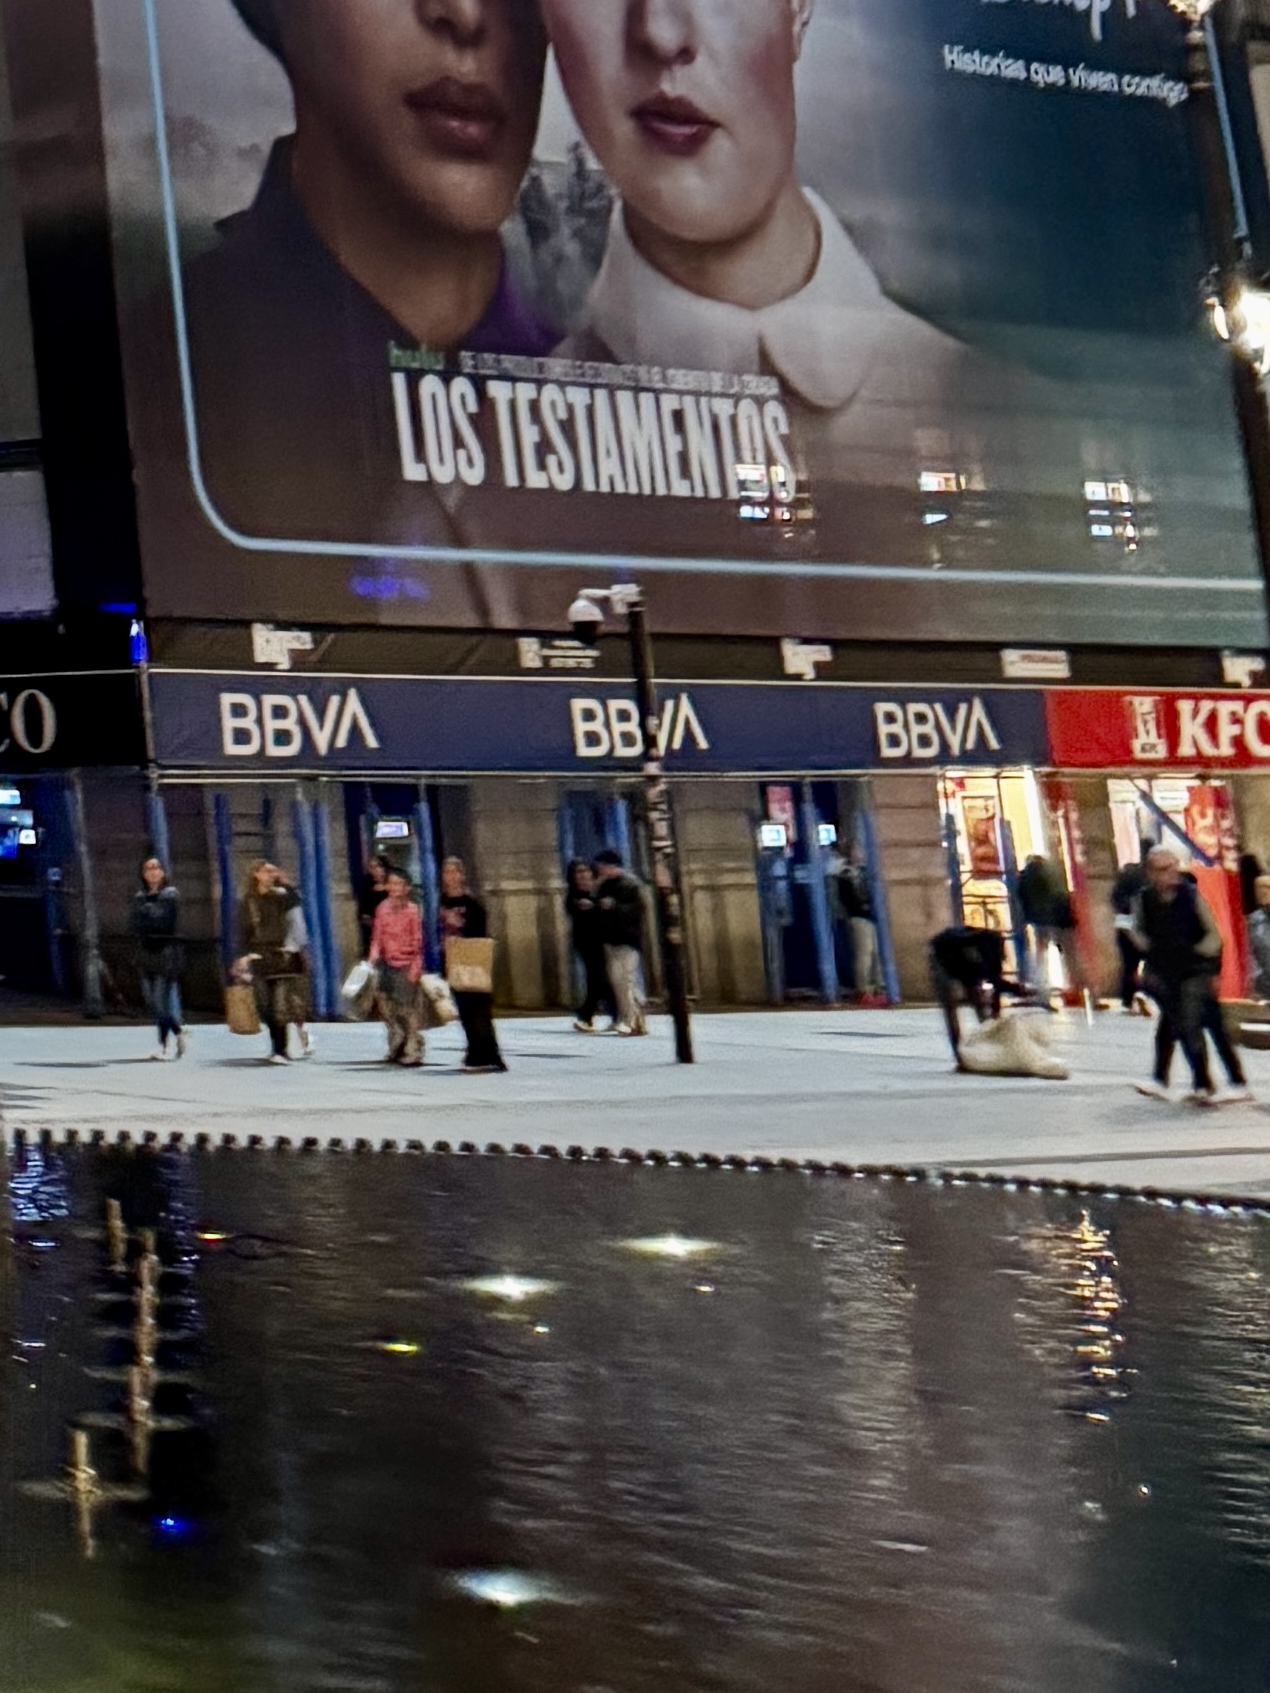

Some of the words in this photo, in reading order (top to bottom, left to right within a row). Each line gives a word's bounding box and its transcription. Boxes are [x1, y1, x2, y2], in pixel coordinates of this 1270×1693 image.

[1030, 61, 1066, 88] que
[390, 372, 486, 485] LOS
[486, 378, 797, 503] TESTAMENTOS
[219, 687, 380, 758] BBVA
[873, 696, 1002, 759] BBVA
